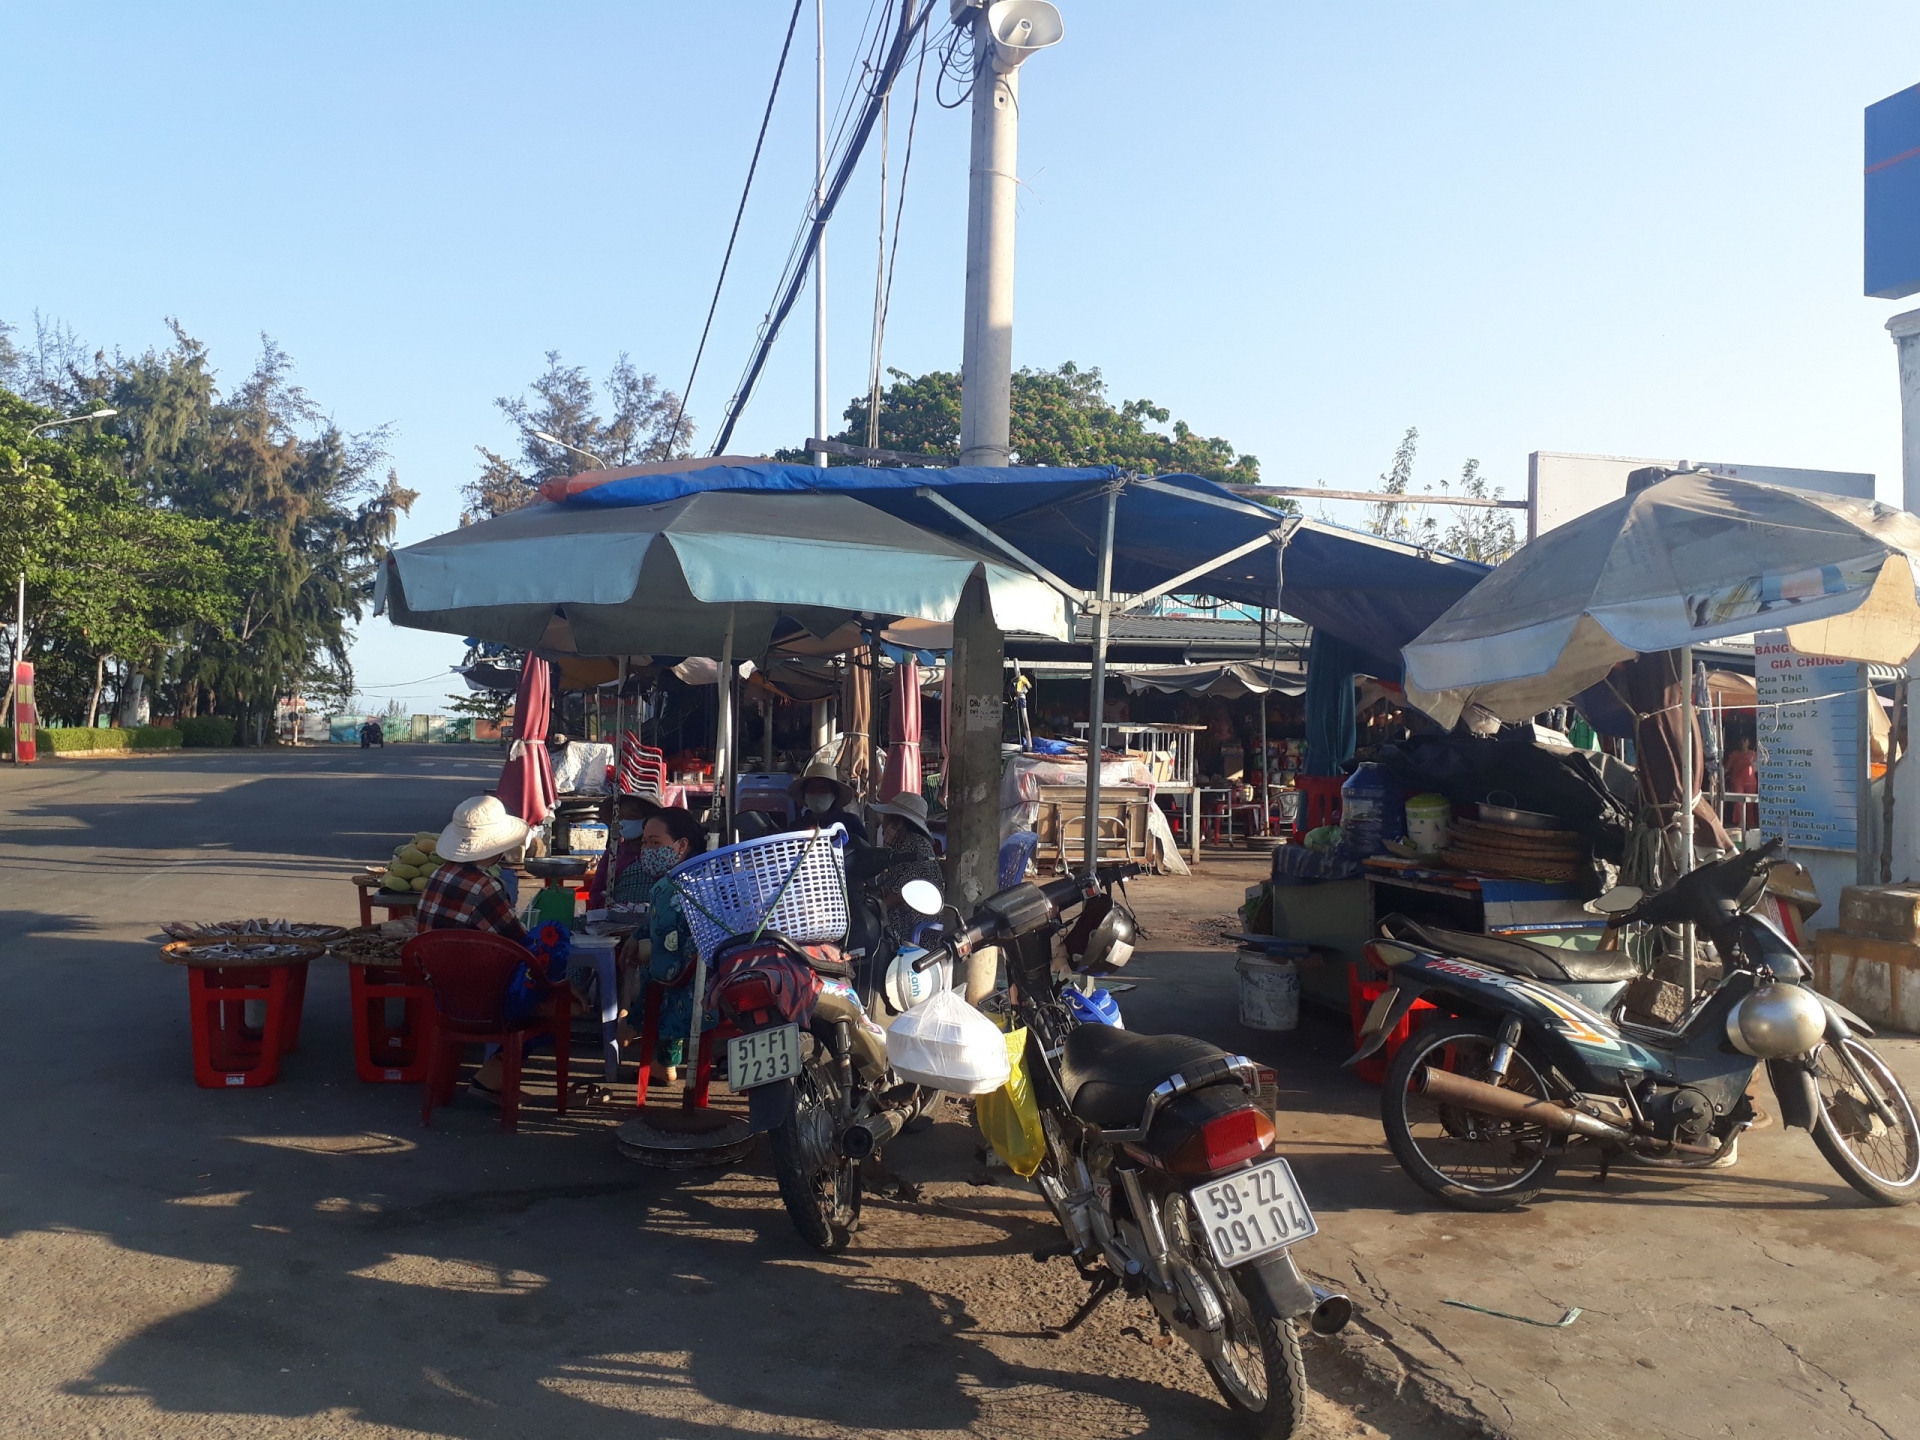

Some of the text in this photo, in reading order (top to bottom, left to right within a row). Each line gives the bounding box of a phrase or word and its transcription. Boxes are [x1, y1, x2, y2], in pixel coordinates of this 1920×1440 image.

[1755, 643, 1789, 655] BẢNG
[1771, 657, 1845, 669] GIÁ CHUNG
[1758, 674, 1803, 683] Cua Thịt
[1758, 686, 1809, 695] Cua Gạch
[1783, 710, 1807, 719] Loại
[1811, 710, 1819, 718] 2
[1778, 747, 1813, 757] Hương
[1761, 783, 1784, 791] Tôm
[738, 1029, 787, 1061] 51-F1
[739, 1053, 790, 1085] 7233
[1206, 1169, 1285, 1219] 59-Z2
[1214, 1200, 1307, 1258] 091.04
